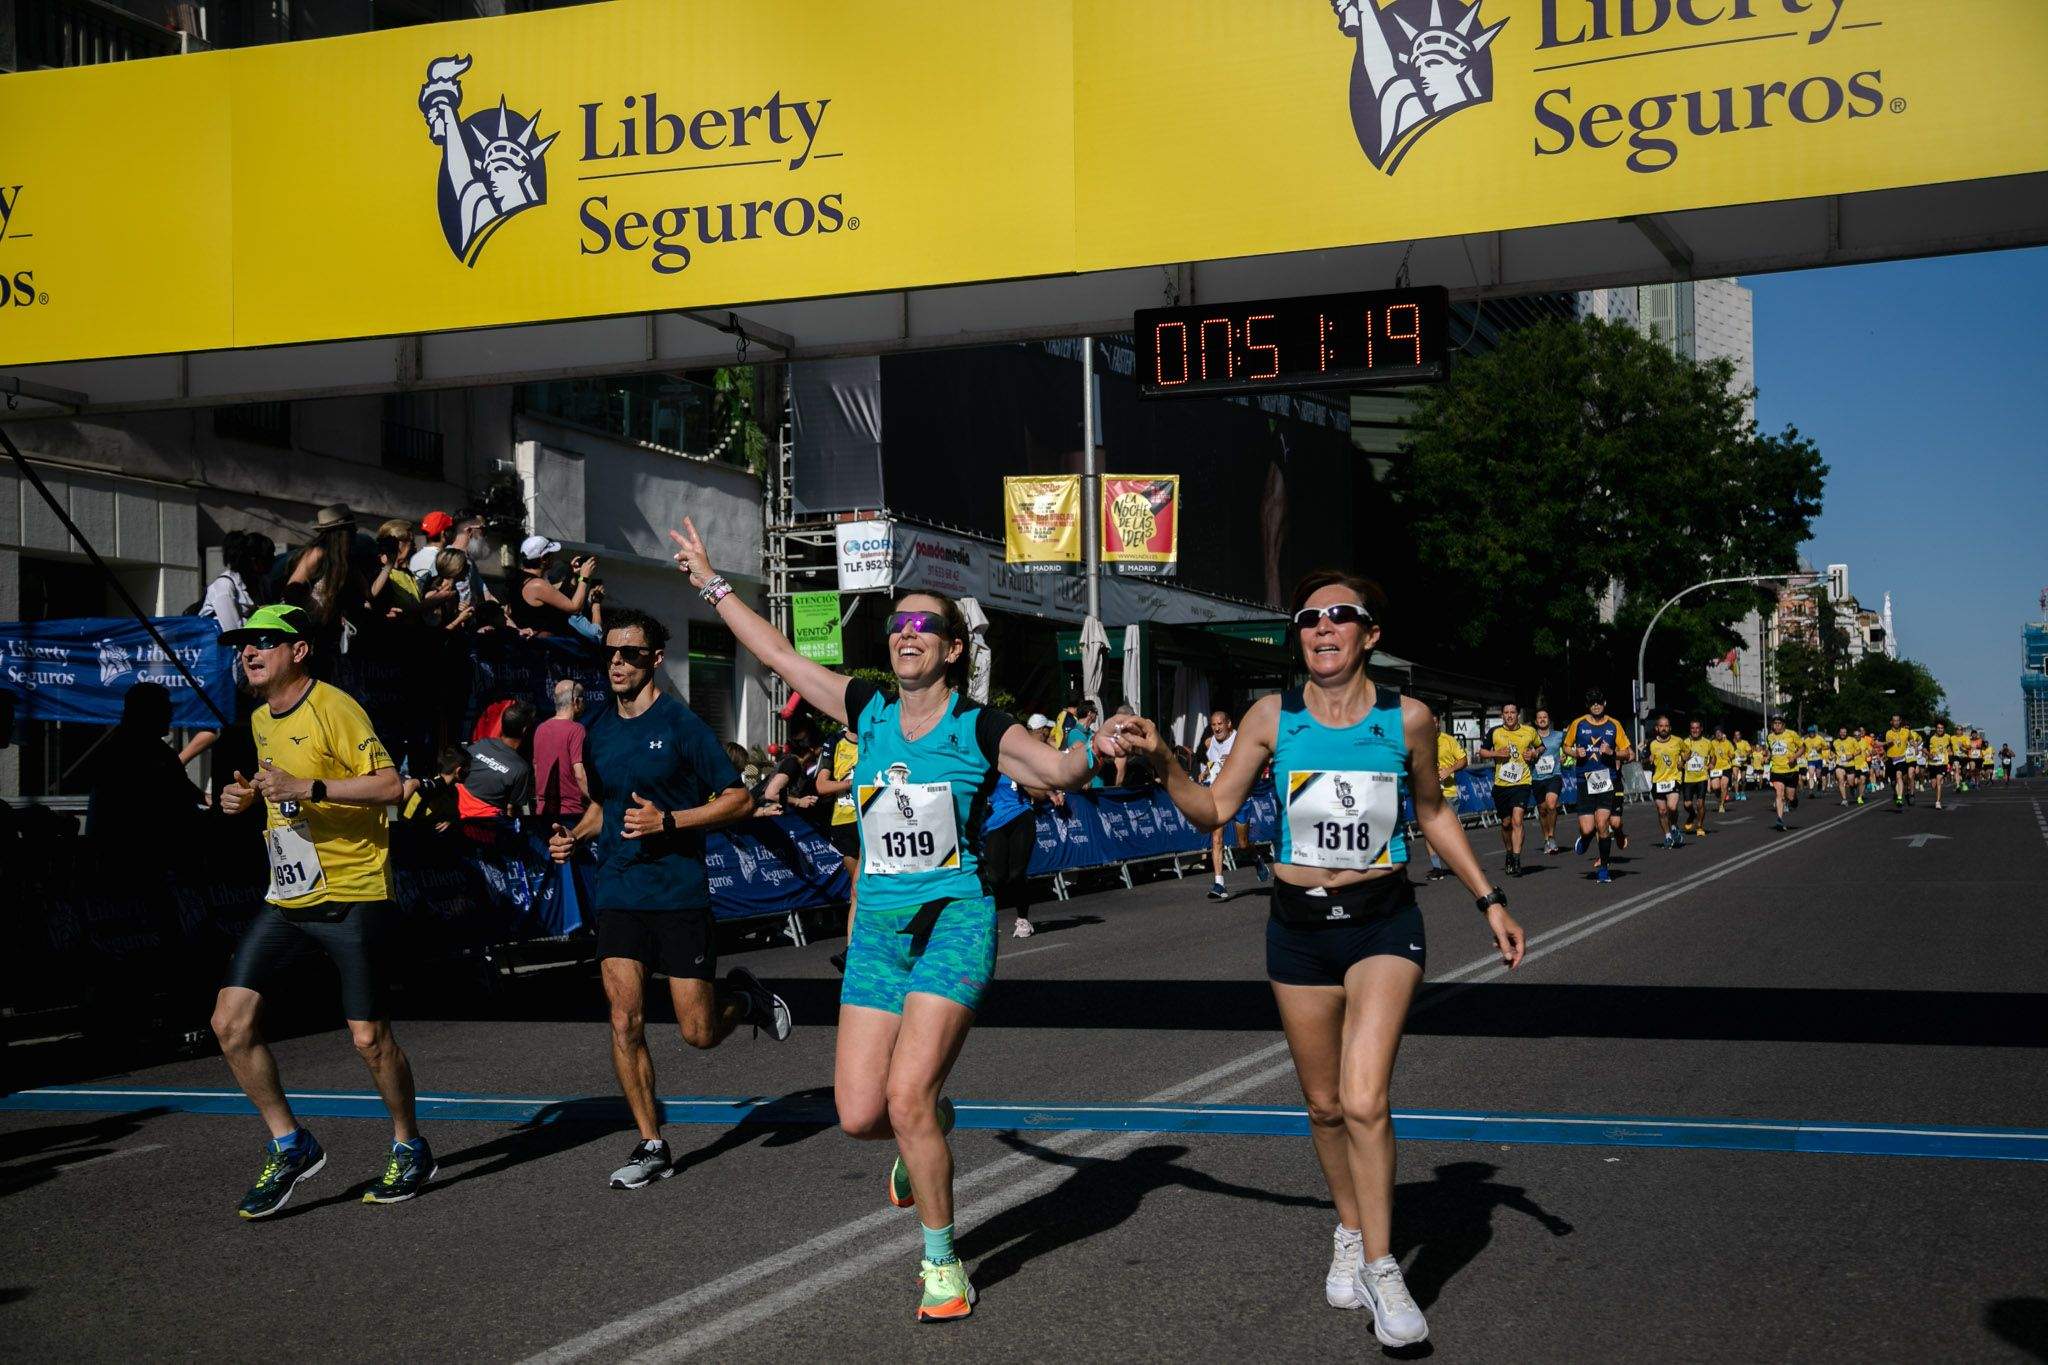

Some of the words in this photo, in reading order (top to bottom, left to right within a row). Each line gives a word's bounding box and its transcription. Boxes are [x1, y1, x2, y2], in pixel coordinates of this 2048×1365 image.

[1535, 0, 1844, 50] Liey
[579, 91, 831, 170] Liberty
[1114, 500, 1149, 517] NOCHE
[1125, 494, 1136, 503] LA
[1119, 518, 1131, 528] DE
[1133, 516, 1153, 530] LAS
[1123, 528, 1153, 547] IDEAS
[844, 561, 863, 573] TLF.
[865, 560, 882, 571] 952
[8, 640, 71, 667] Liberty
[8, 666, 76, 690] Seguros
[882, 831, 935, 858] 1319
[1313, 821, 1369, 850] 1318
